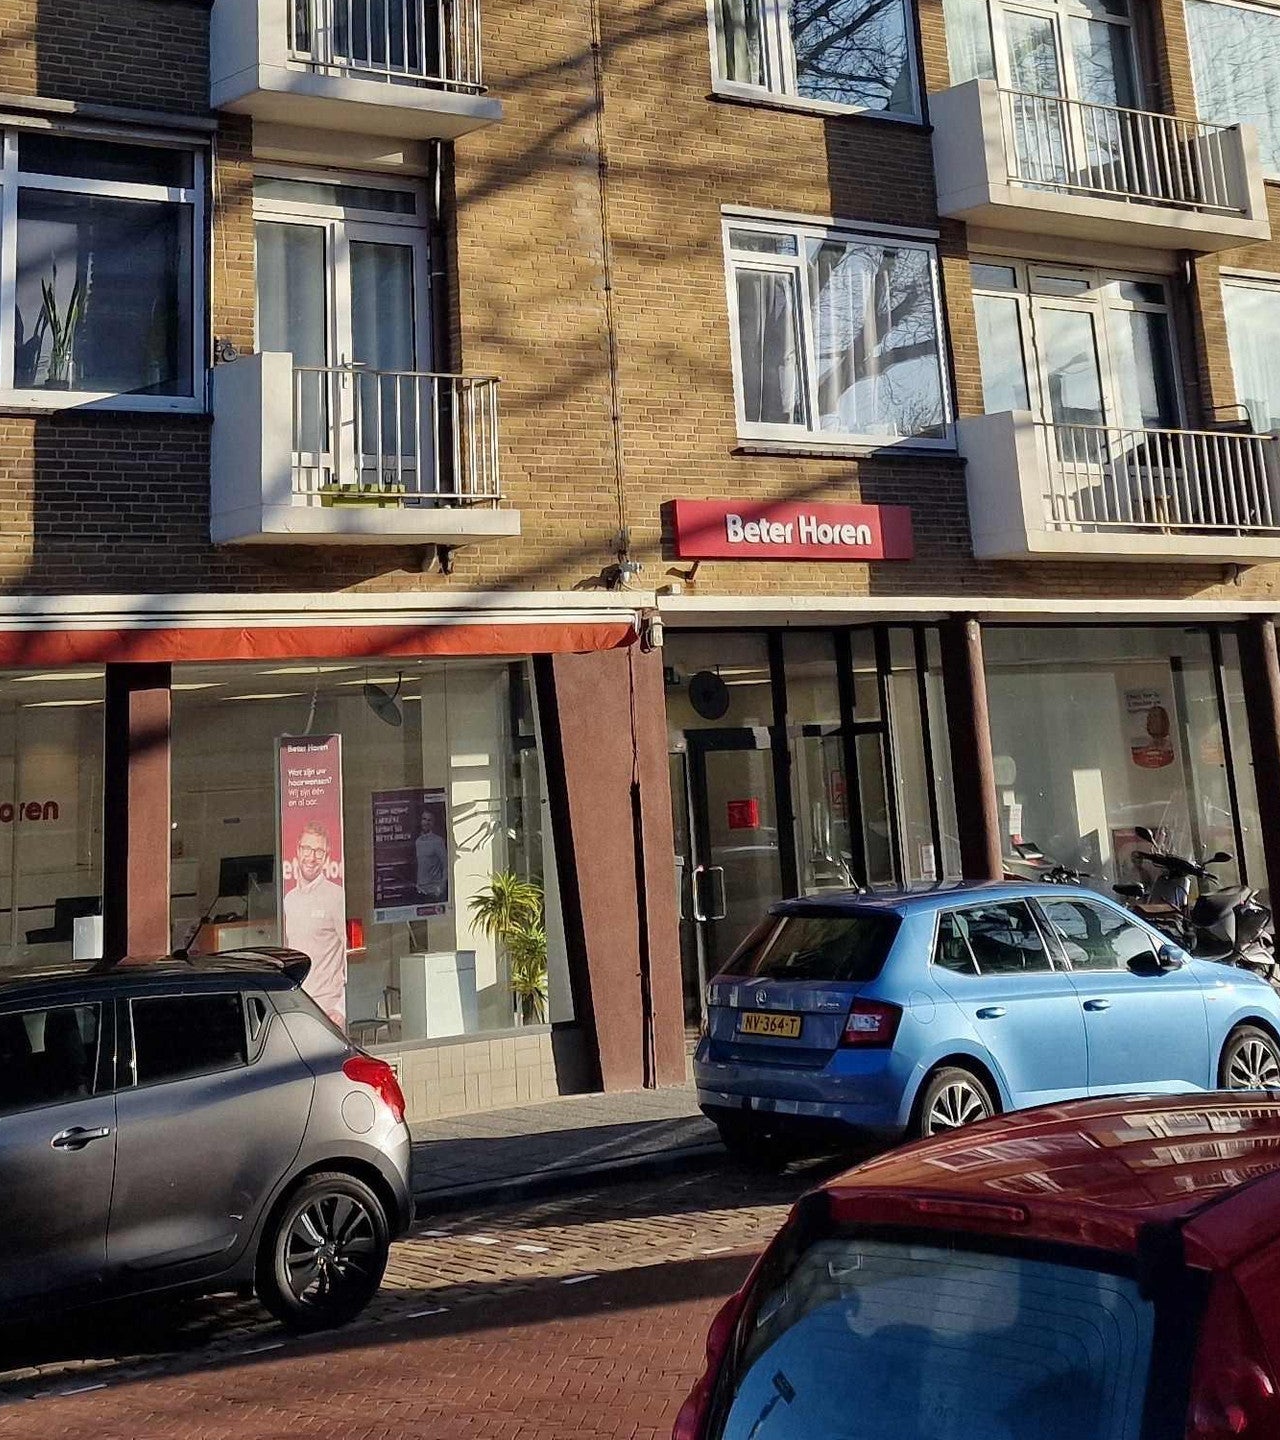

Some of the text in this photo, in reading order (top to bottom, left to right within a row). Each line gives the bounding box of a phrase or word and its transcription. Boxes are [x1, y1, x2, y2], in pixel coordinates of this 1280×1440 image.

[726, 514, 872, 545] Beter Horen
[744, 1012, 798, 1034] NV-364-T
